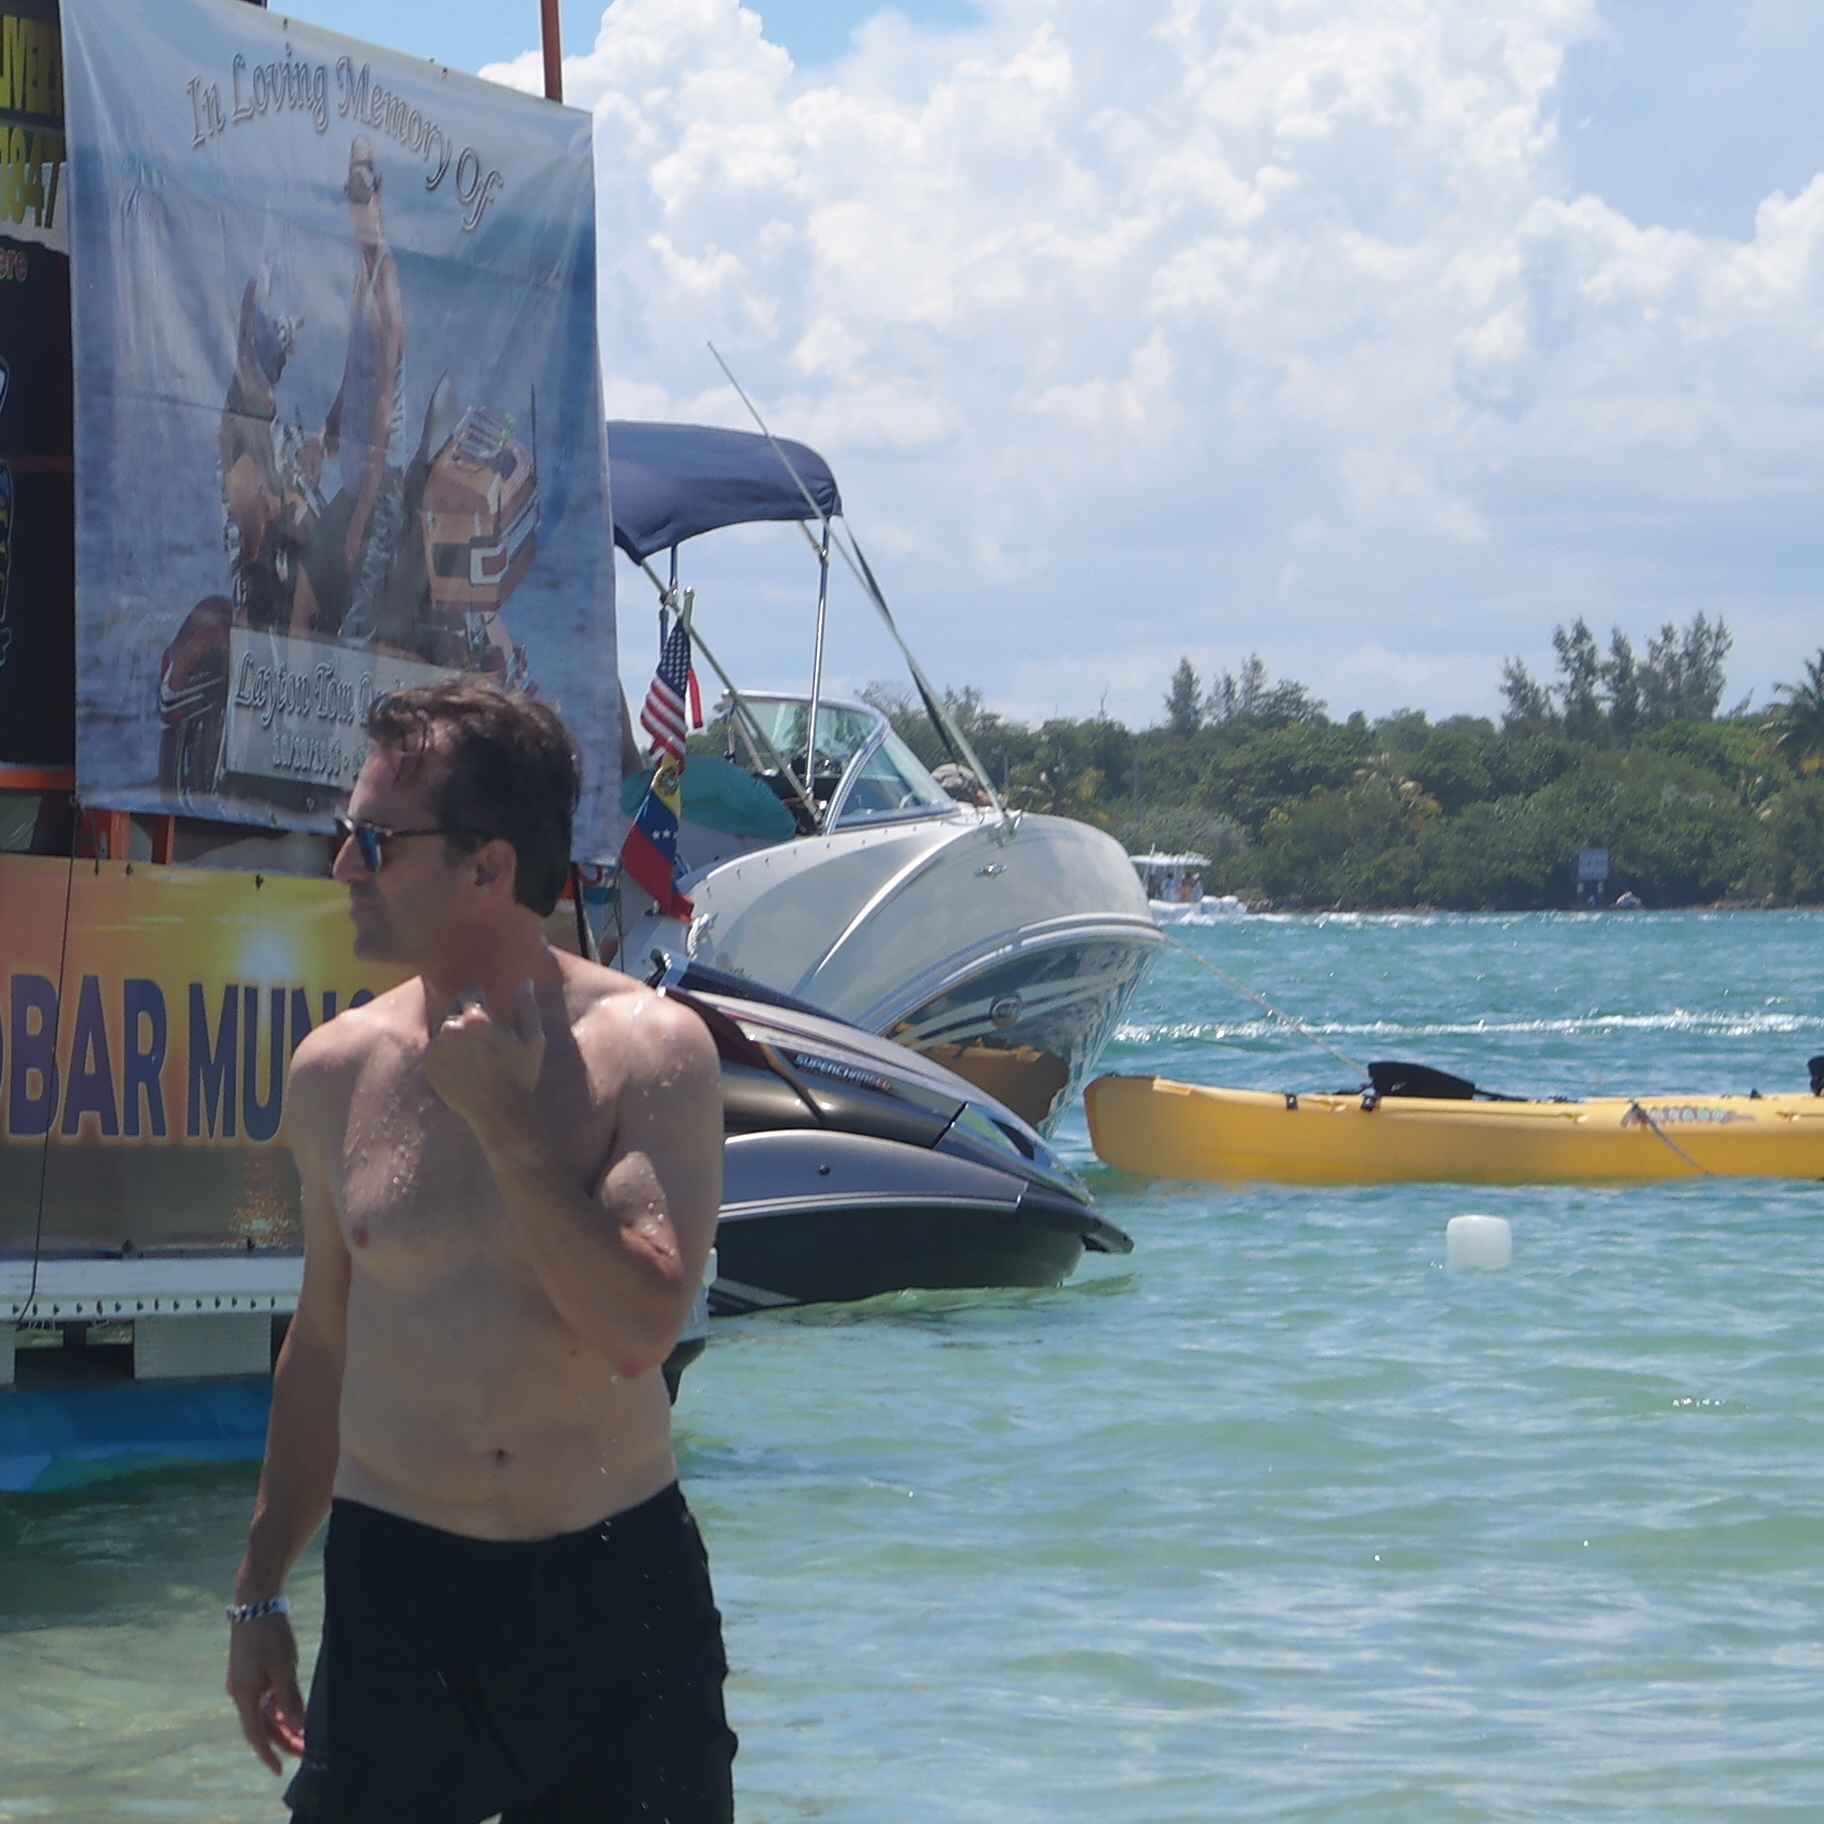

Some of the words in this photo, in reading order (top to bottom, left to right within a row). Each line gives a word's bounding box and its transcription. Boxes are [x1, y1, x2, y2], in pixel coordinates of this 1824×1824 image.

[186, 74, 226, 152] In
[230, 42, 330, 135] Loving
[335, 54, 453, 192] Memory
[455, 145, 504, 233] Of
[235, 651, 311, 728] Layton
